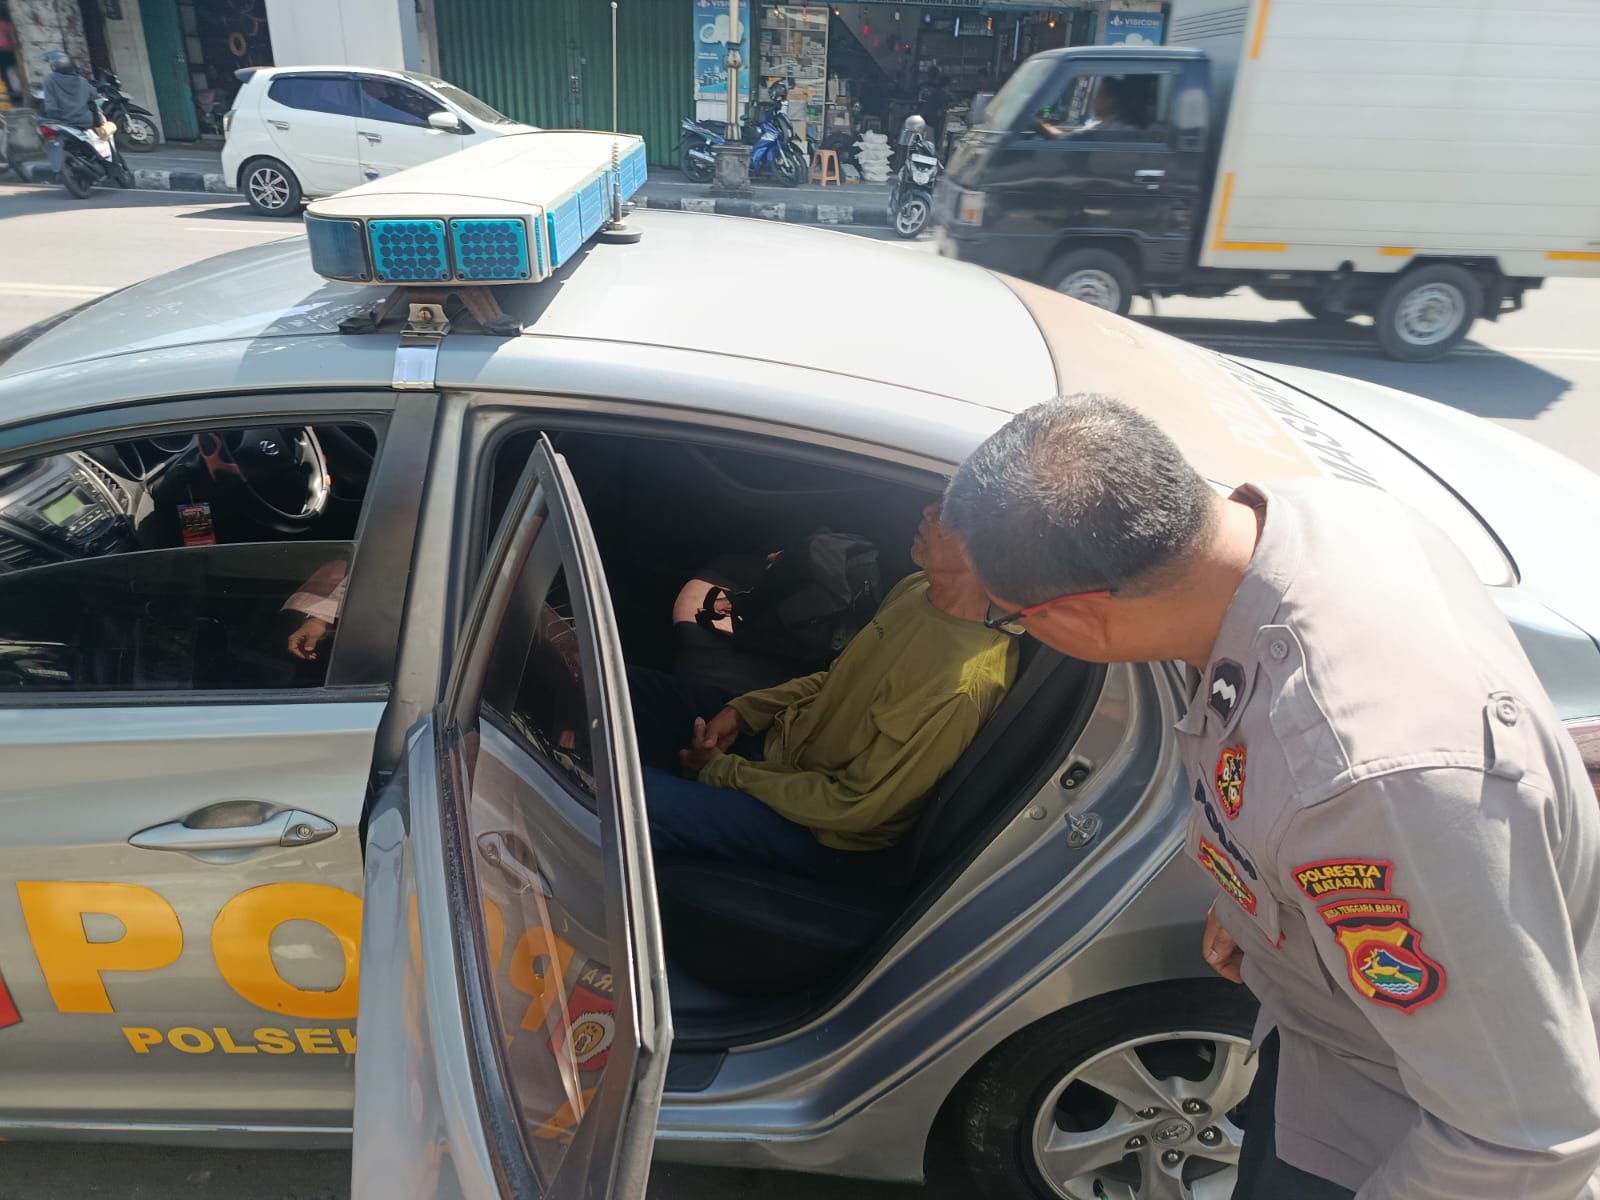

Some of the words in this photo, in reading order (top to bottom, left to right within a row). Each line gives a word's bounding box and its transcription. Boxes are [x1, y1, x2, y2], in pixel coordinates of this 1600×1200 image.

[1298, 865, 1382, 890] POLRESTA
[1312, 878, 1375, 894] MATARAM
[1337, 903, 1374, 914] TENGGARA
[1375, 904, 1402, 913] BARAT
